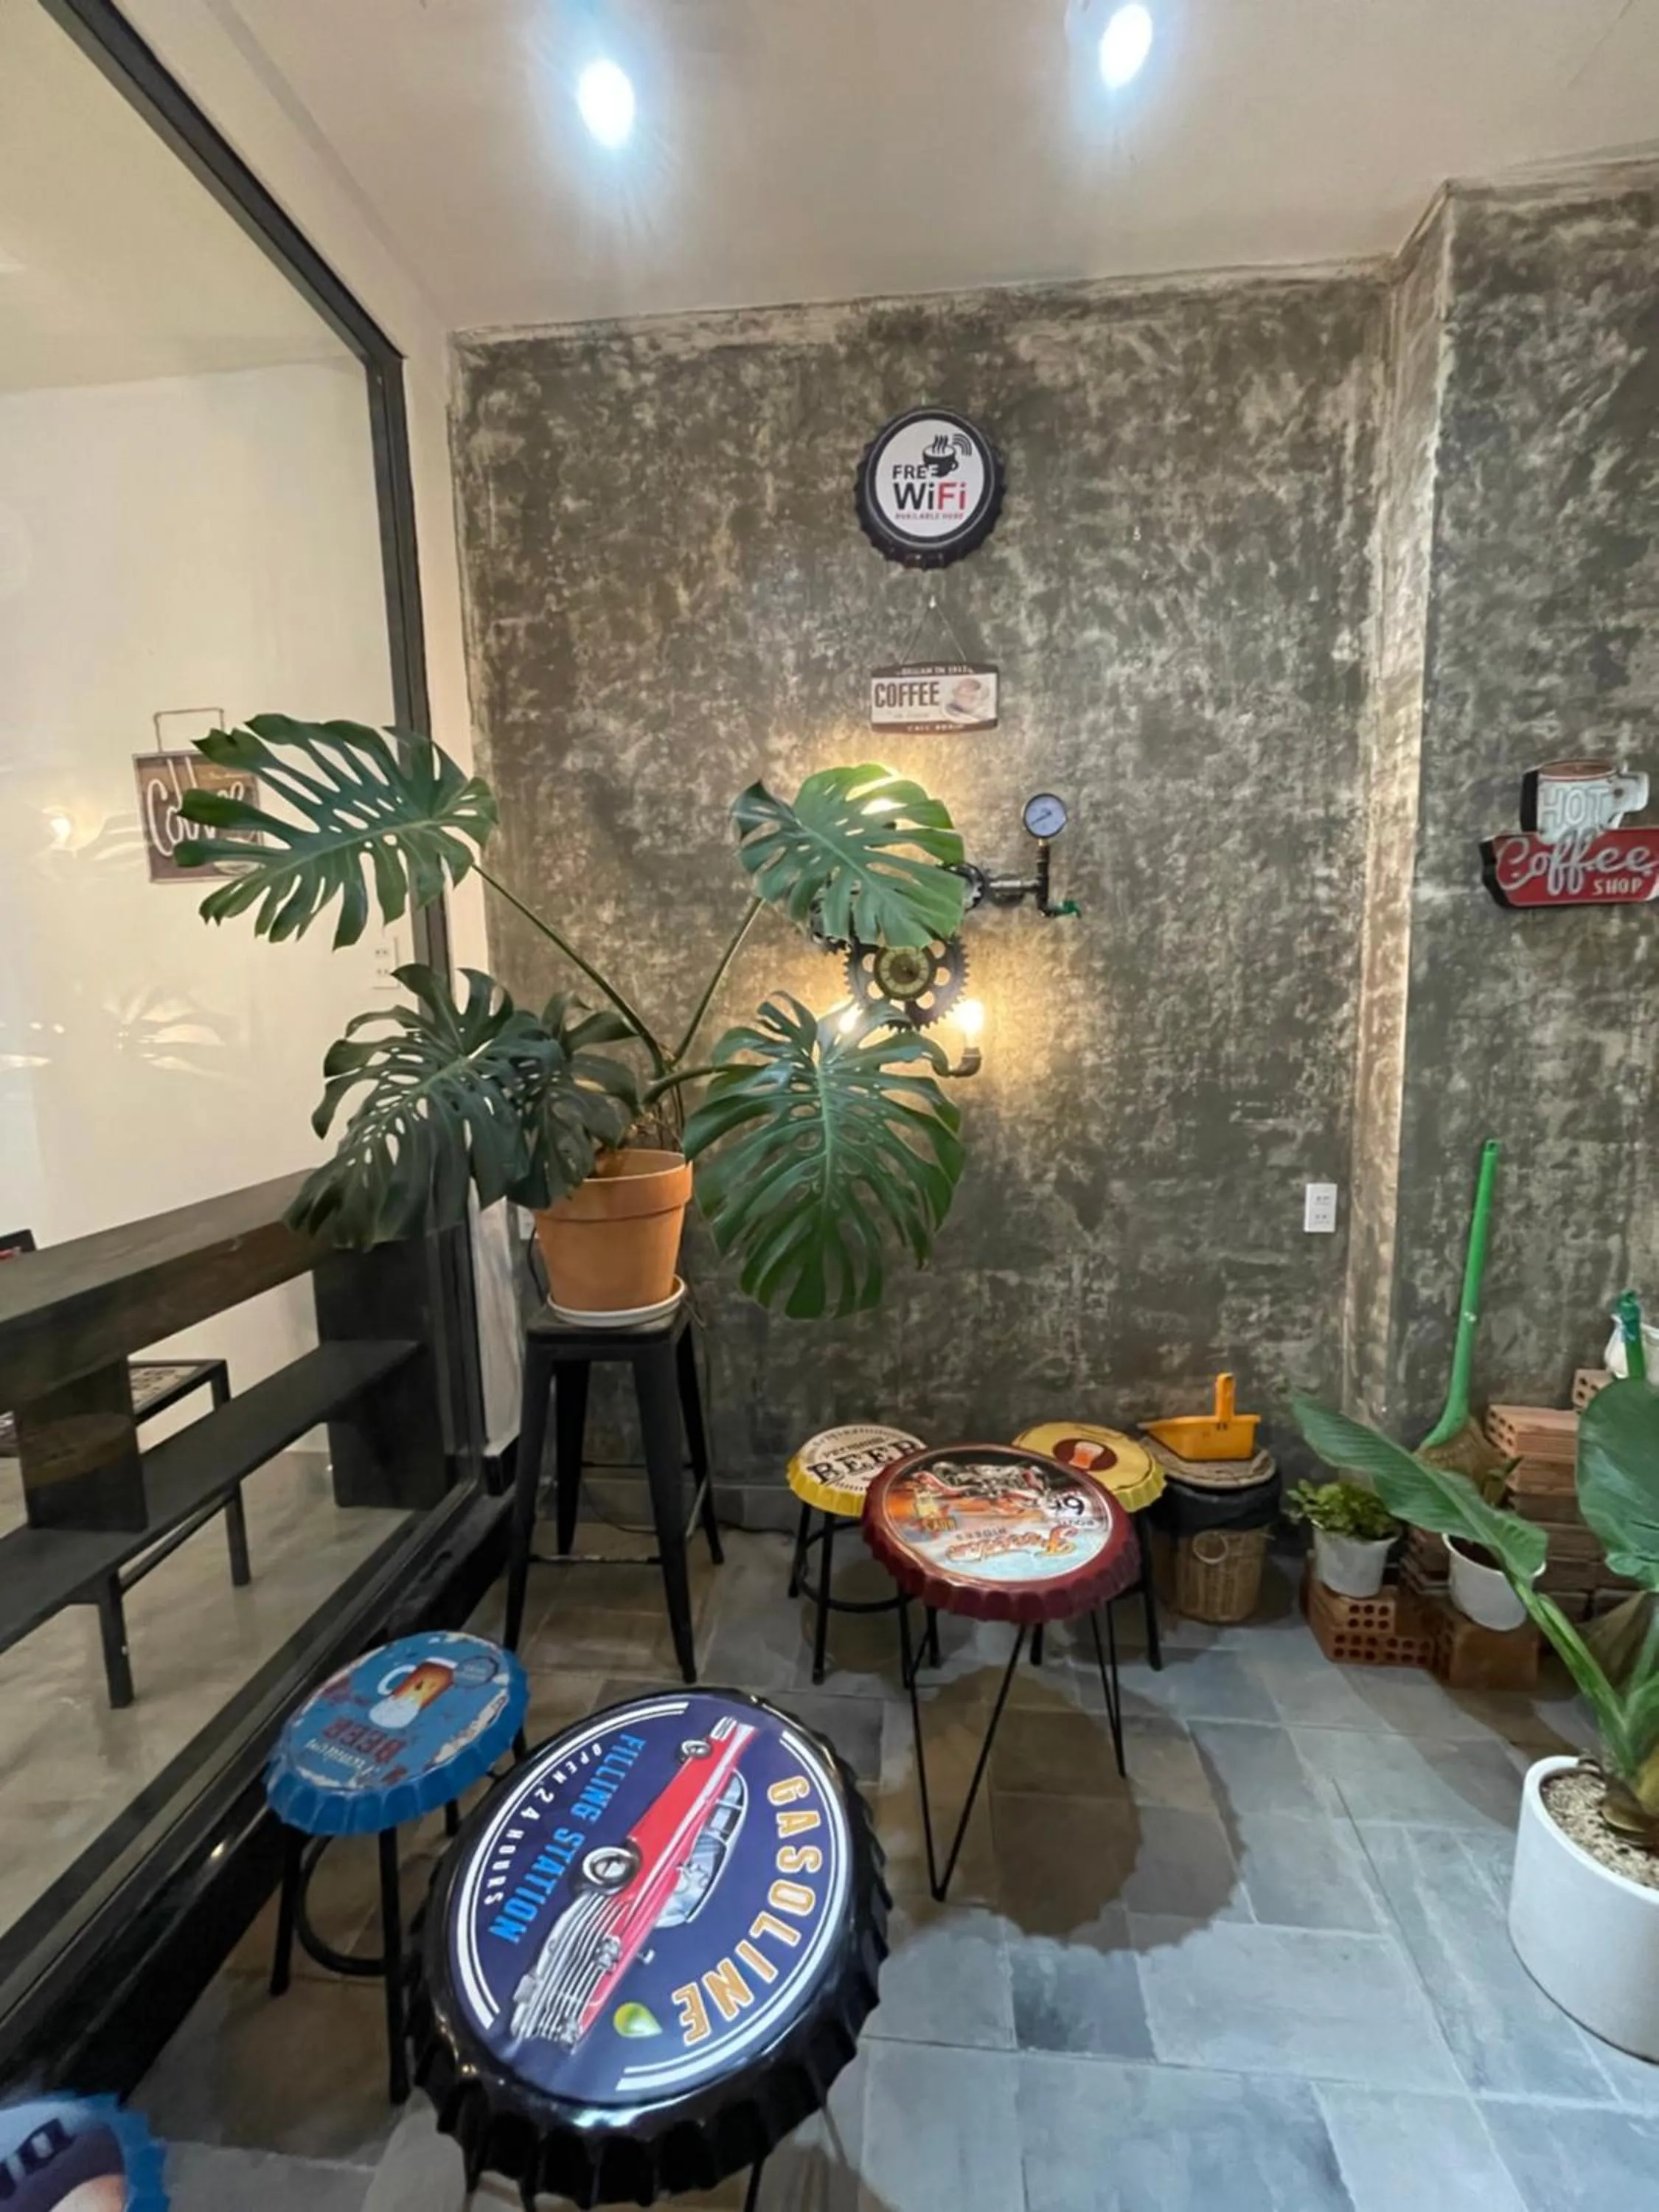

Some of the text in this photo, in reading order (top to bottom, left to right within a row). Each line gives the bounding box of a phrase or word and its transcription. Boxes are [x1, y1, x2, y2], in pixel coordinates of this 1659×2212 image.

[891, 464, 940, 480] FREE
[893, 481, 967, 510] WiFi
[874, 681, 940, 709] COFFEE
[1538, 784, 1610, 830] HOT
[1495, 827, 1659, 897] Coffee
[1592, 877, 1644, 897] SHOP
[807, 1439, 919, 1484] BEER
[484, 1742, 603, 1906] OPEN 24 HOURS
[487, 1733, 647, 1944] FILLING STATION
[671, 1775, 824, 2047] GASOLINE
